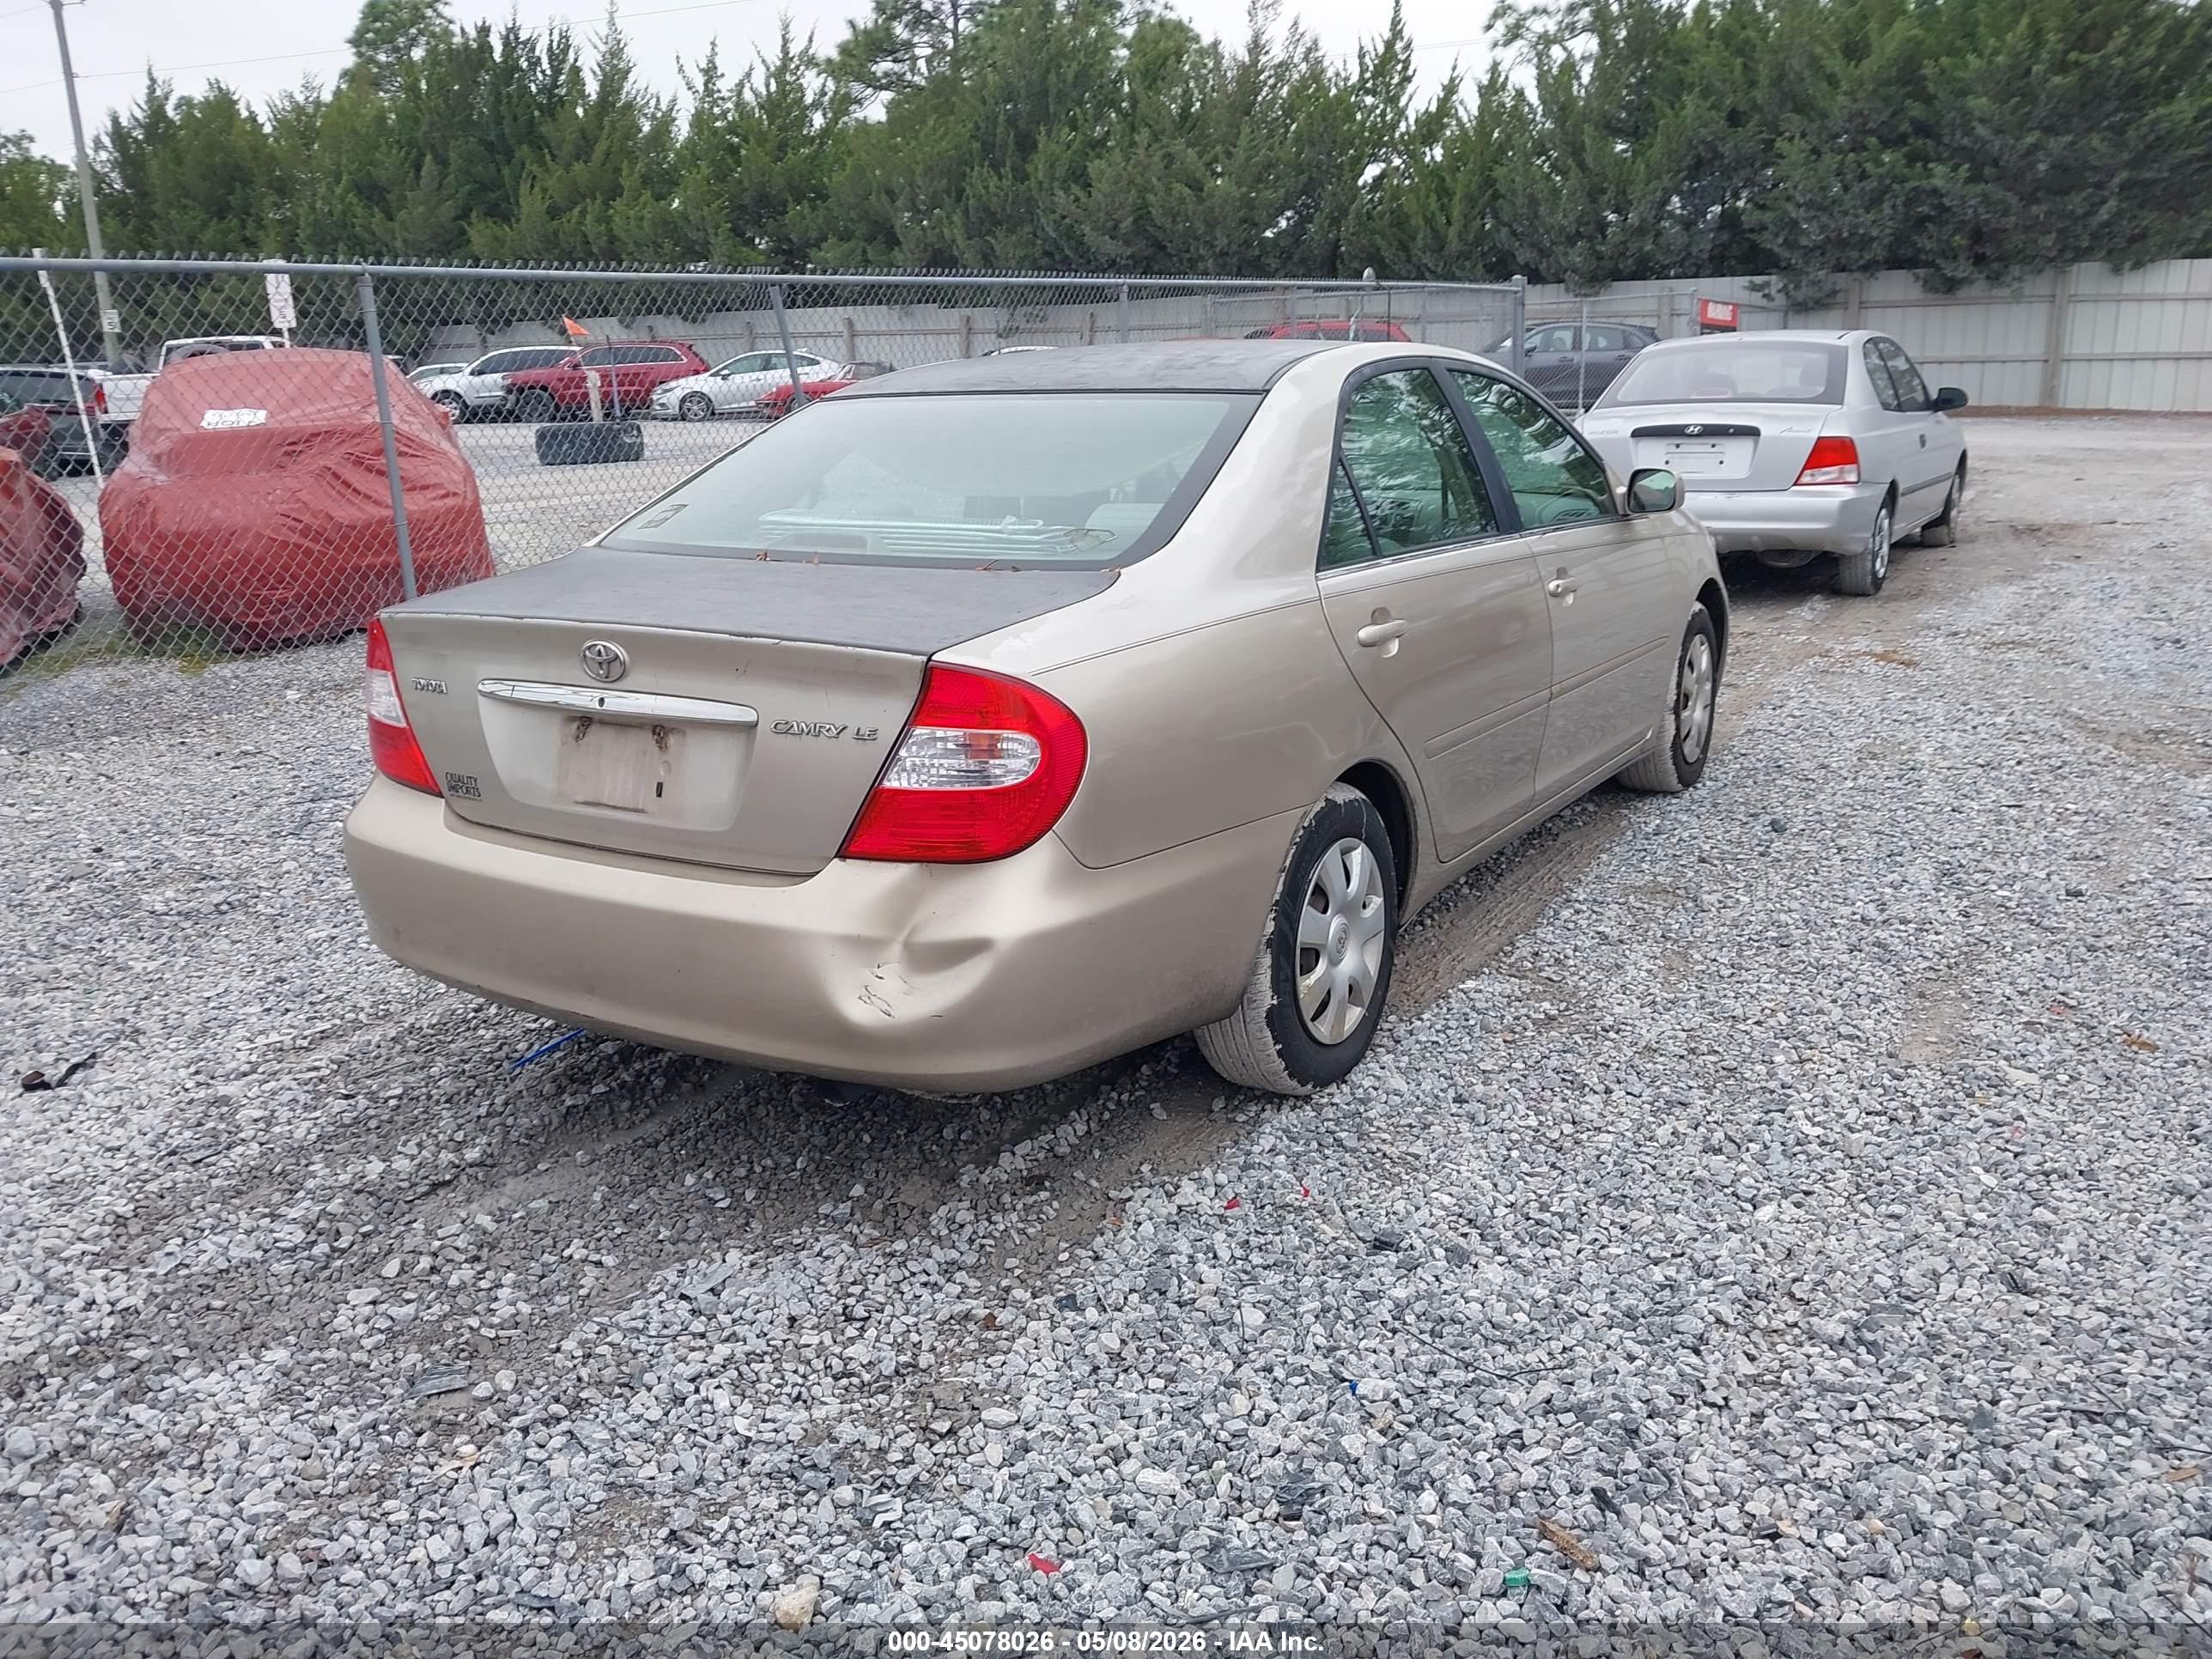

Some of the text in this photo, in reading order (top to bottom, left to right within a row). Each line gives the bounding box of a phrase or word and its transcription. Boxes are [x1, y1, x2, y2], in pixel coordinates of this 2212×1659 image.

[769, 719, 878, 740] CAMRY LE
[445, 771, 477, 787] QUALITY
[446, 781, 482, 798] IMPORTS
